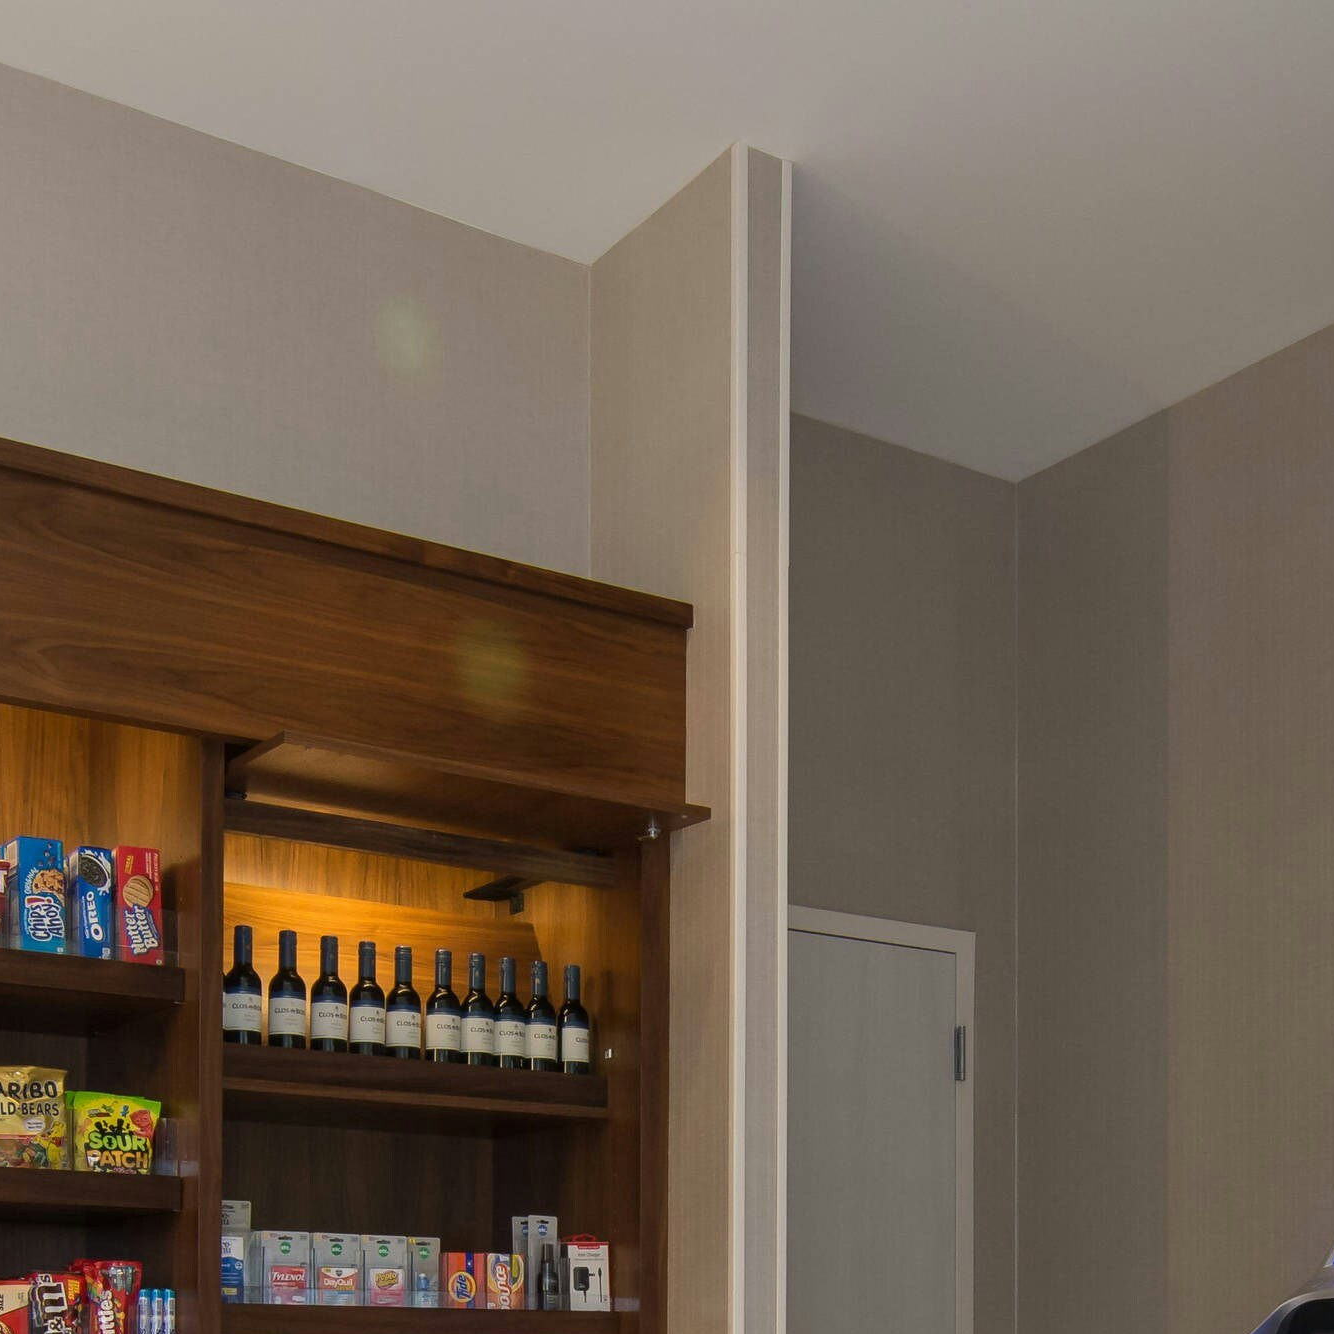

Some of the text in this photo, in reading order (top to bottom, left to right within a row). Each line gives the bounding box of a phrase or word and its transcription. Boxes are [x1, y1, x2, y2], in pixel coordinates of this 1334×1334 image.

[29, 904, 50, 941] Chips
[86, 891, 103, 941] OREO
[134, 905, 159, 951] Butter
[123, 909, 147, 955] Nutter
[88, 1130, 147, 1151] SOUR
[87, 1150, 149, 1169] PATCH
[271, 1271, 306, 1281] TYLENOL
[323, 1279, 353, 1287] DayQuil
[456, 1275, 470, 1299] Tide
